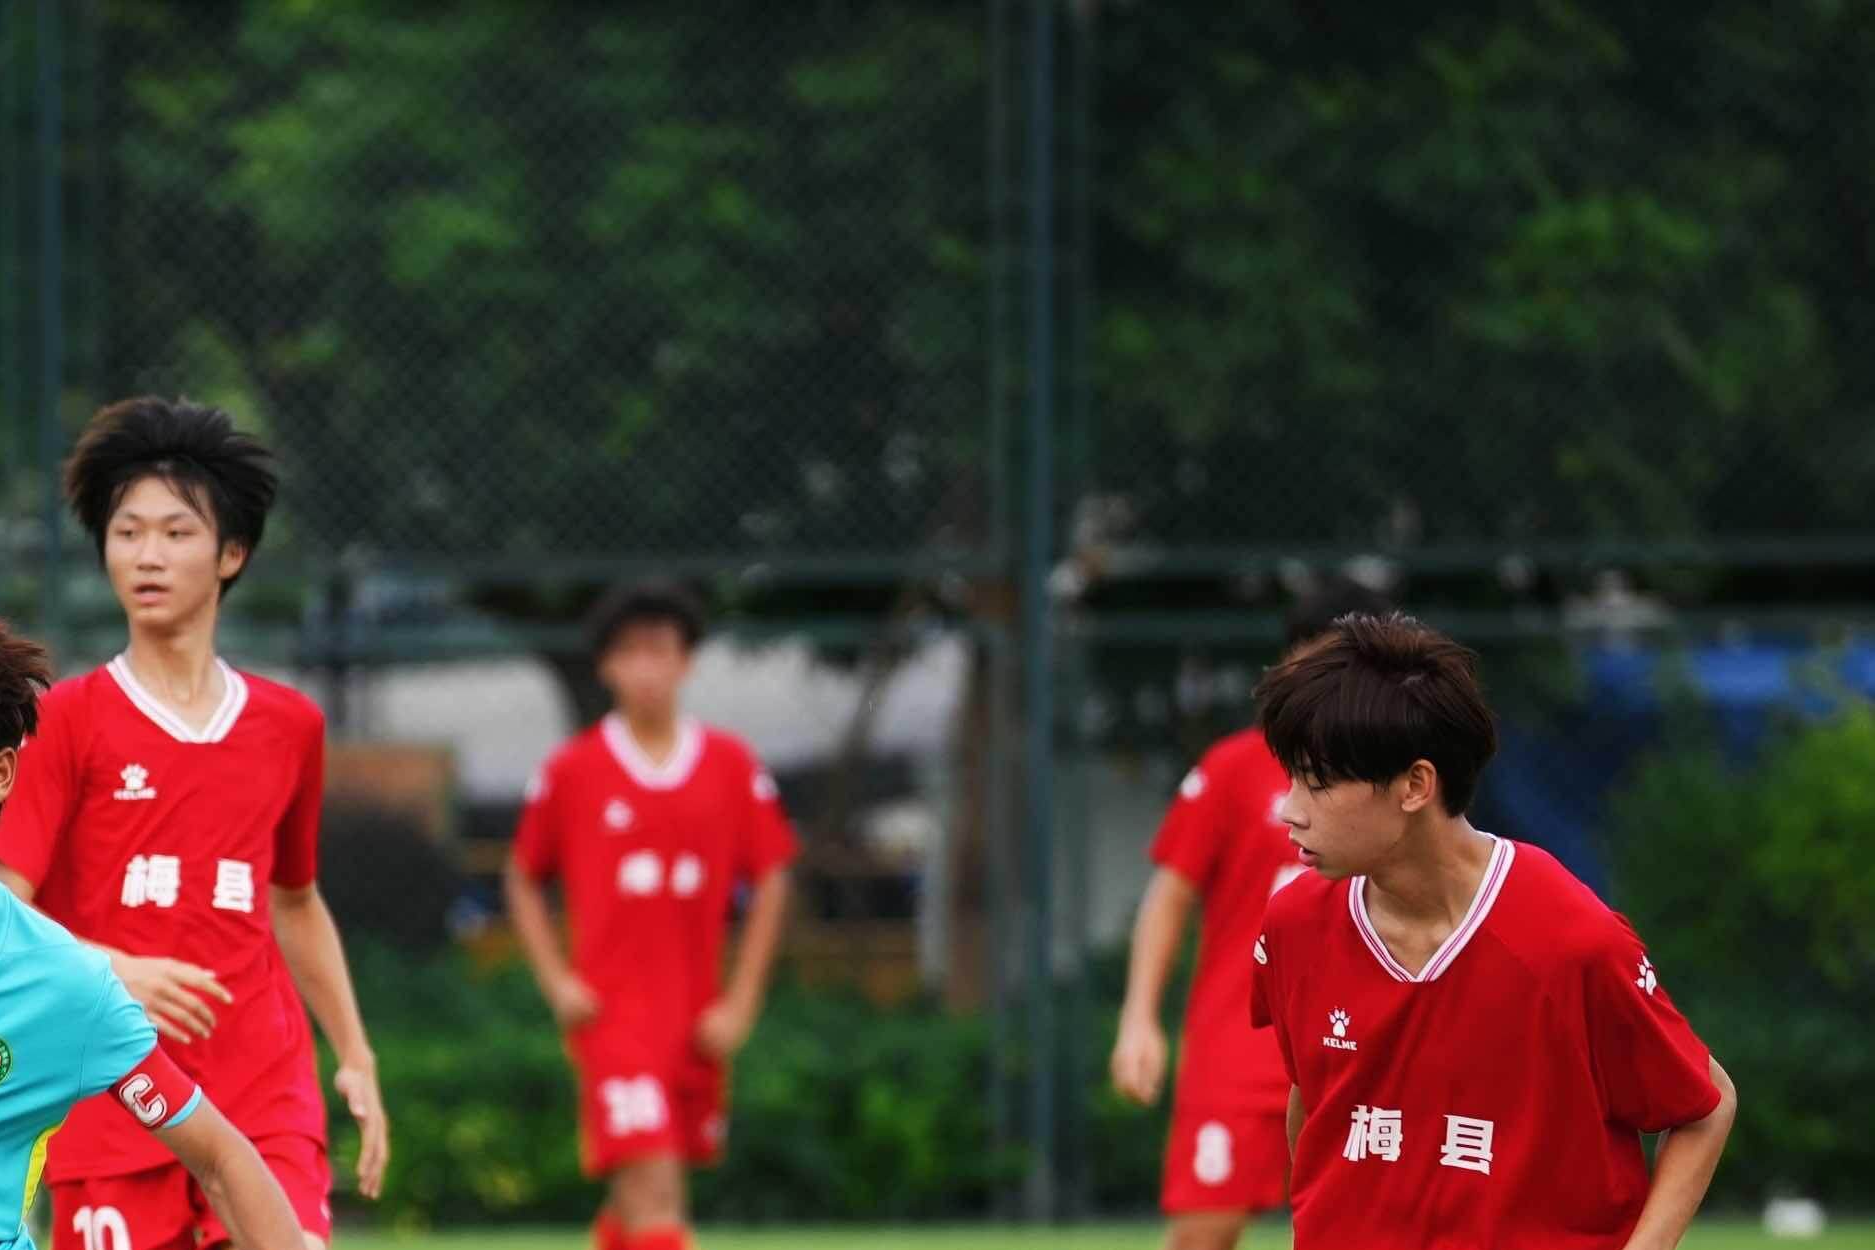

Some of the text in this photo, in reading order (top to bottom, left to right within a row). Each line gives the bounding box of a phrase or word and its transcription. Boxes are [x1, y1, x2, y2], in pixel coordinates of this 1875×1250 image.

[121, 854, 255, 913] 梅县
[1323, 1036, 1358, 1051] KELME
[119, 1073, 168, 1126] C
[1342, 1104, 1495, 1176] 梅县
